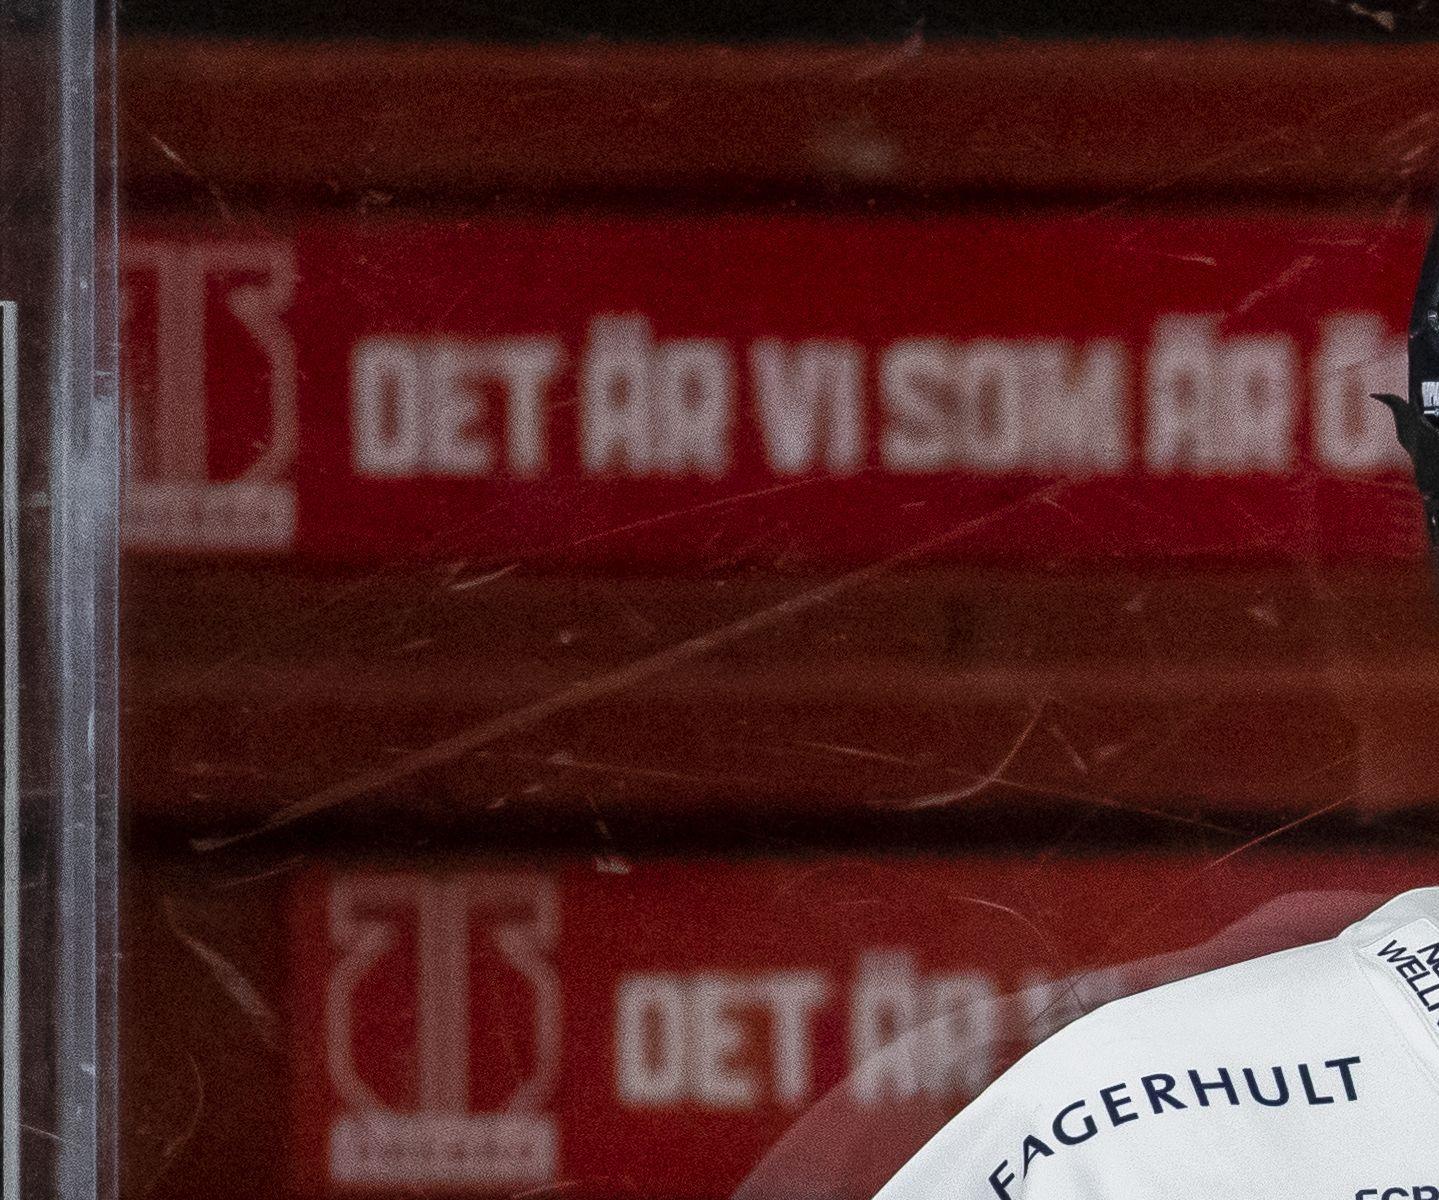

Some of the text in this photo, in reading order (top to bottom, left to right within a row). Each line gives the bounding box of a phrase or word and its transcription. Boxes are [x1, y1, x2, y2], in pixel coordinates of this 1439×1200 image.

[350, 334, 566, 479] DET
[749, 334, 867, 479] VI
[880, 334, 1129, 475] SOM
[615, 972, 830, 1107] DET
